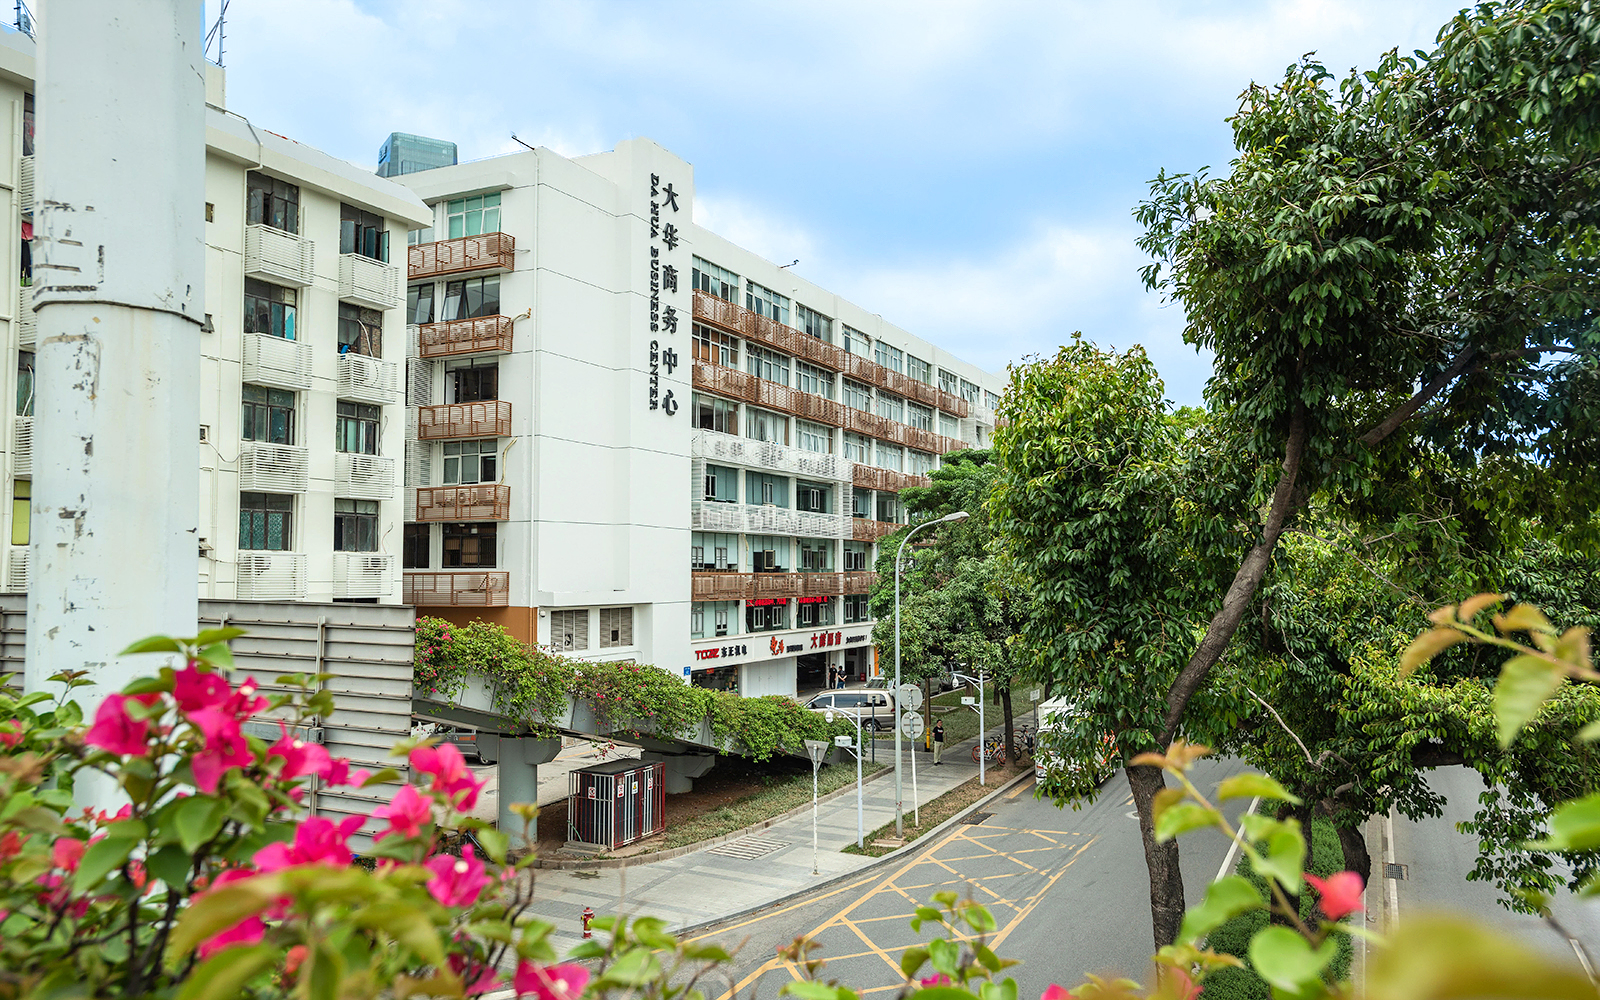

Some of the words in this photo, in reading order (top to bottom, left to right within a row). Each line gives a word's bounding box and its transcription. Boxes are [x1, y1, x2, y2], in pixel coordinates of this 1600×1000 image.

[650, 172, 660, 198] DA
[650, 200, 660, 239] HUA
[650, 245, 659, 332] BUSINESS
[662, 182, 679, 416] 大华商务中心
[649, 339, 659, 411] CENTER
